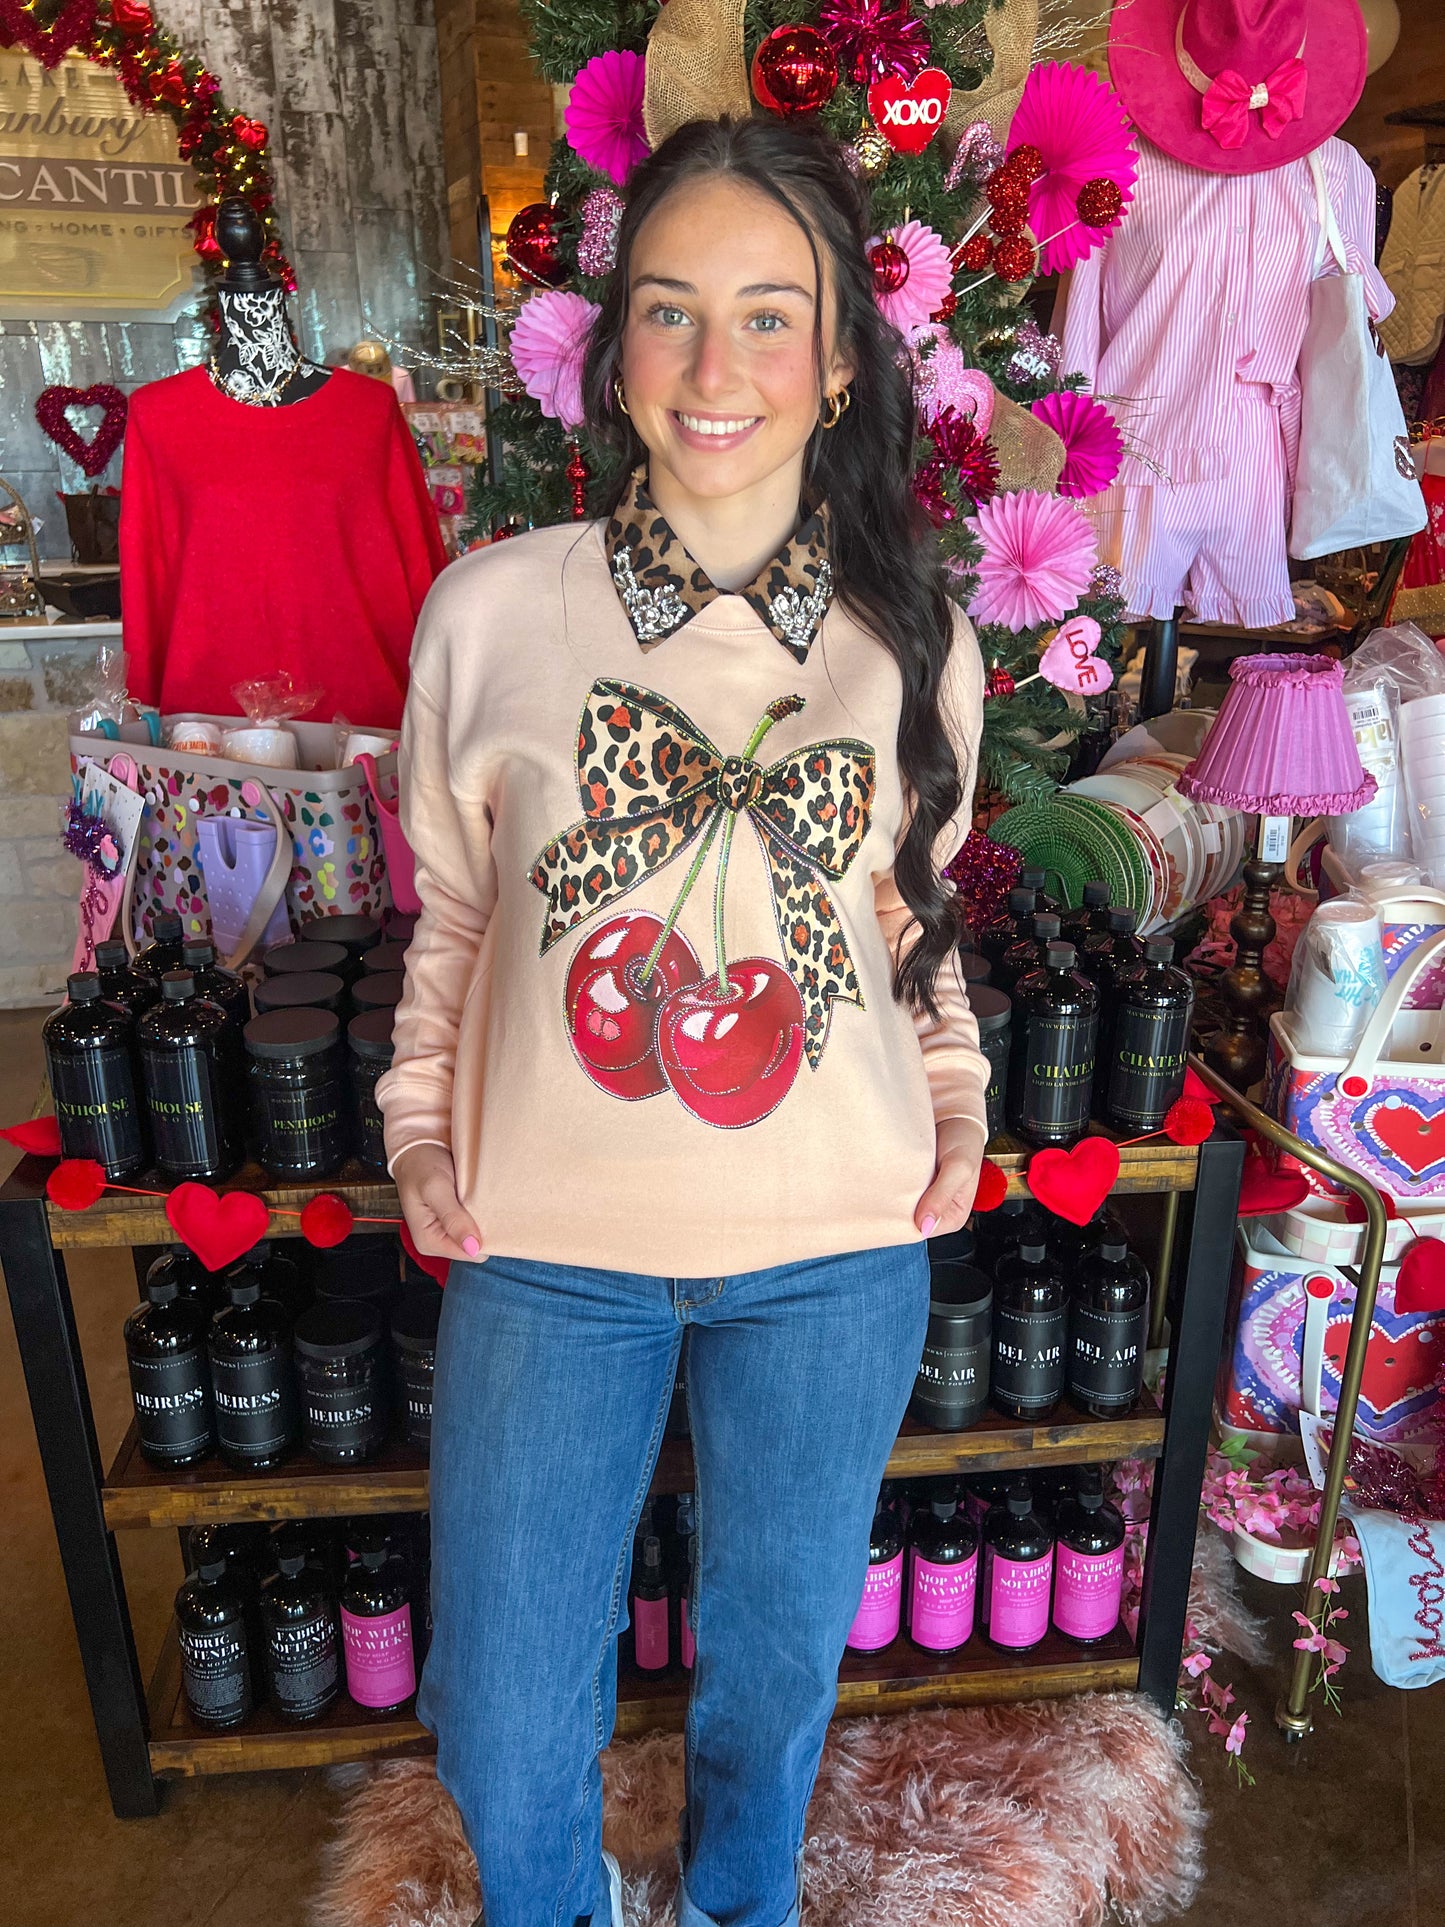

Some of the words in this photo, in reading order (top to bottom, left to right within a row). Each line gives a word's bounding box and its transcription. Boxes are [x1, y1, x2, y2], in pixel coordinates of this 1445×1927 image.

[882, 98, 942, 126] XOXO
[49, 221, 113, 236] HOME
[133, 225, 193, 240] GIFTS
[1011, 351, 1052, 380] LOVE
[1065, 628, 1098, 688] LOVE
[999, 1341, 1027, 1362] BEL
[1033, 1346, 1060, 1362] AIR
[1076, 1338, 1105, 1360] BEL
[1110, 1345, 1137, 1361] AIR
[1030, 1359, 1060, 1370] SOAP
[1108, 1357, 1137, 1369] SOAP
[949, 1367, 976, 1381] AIR
[135, 1386, 203, 1410] HEIRESS
[215, 1388, 280, 1409] HEIRESS
[309, 1402, 372, 1423] HEIRESS
[920, 1570, 948, 1587] MOP
[277, 1617, 329, 1643] FABRIC
[368, 1619, 406, 1639] WITH
